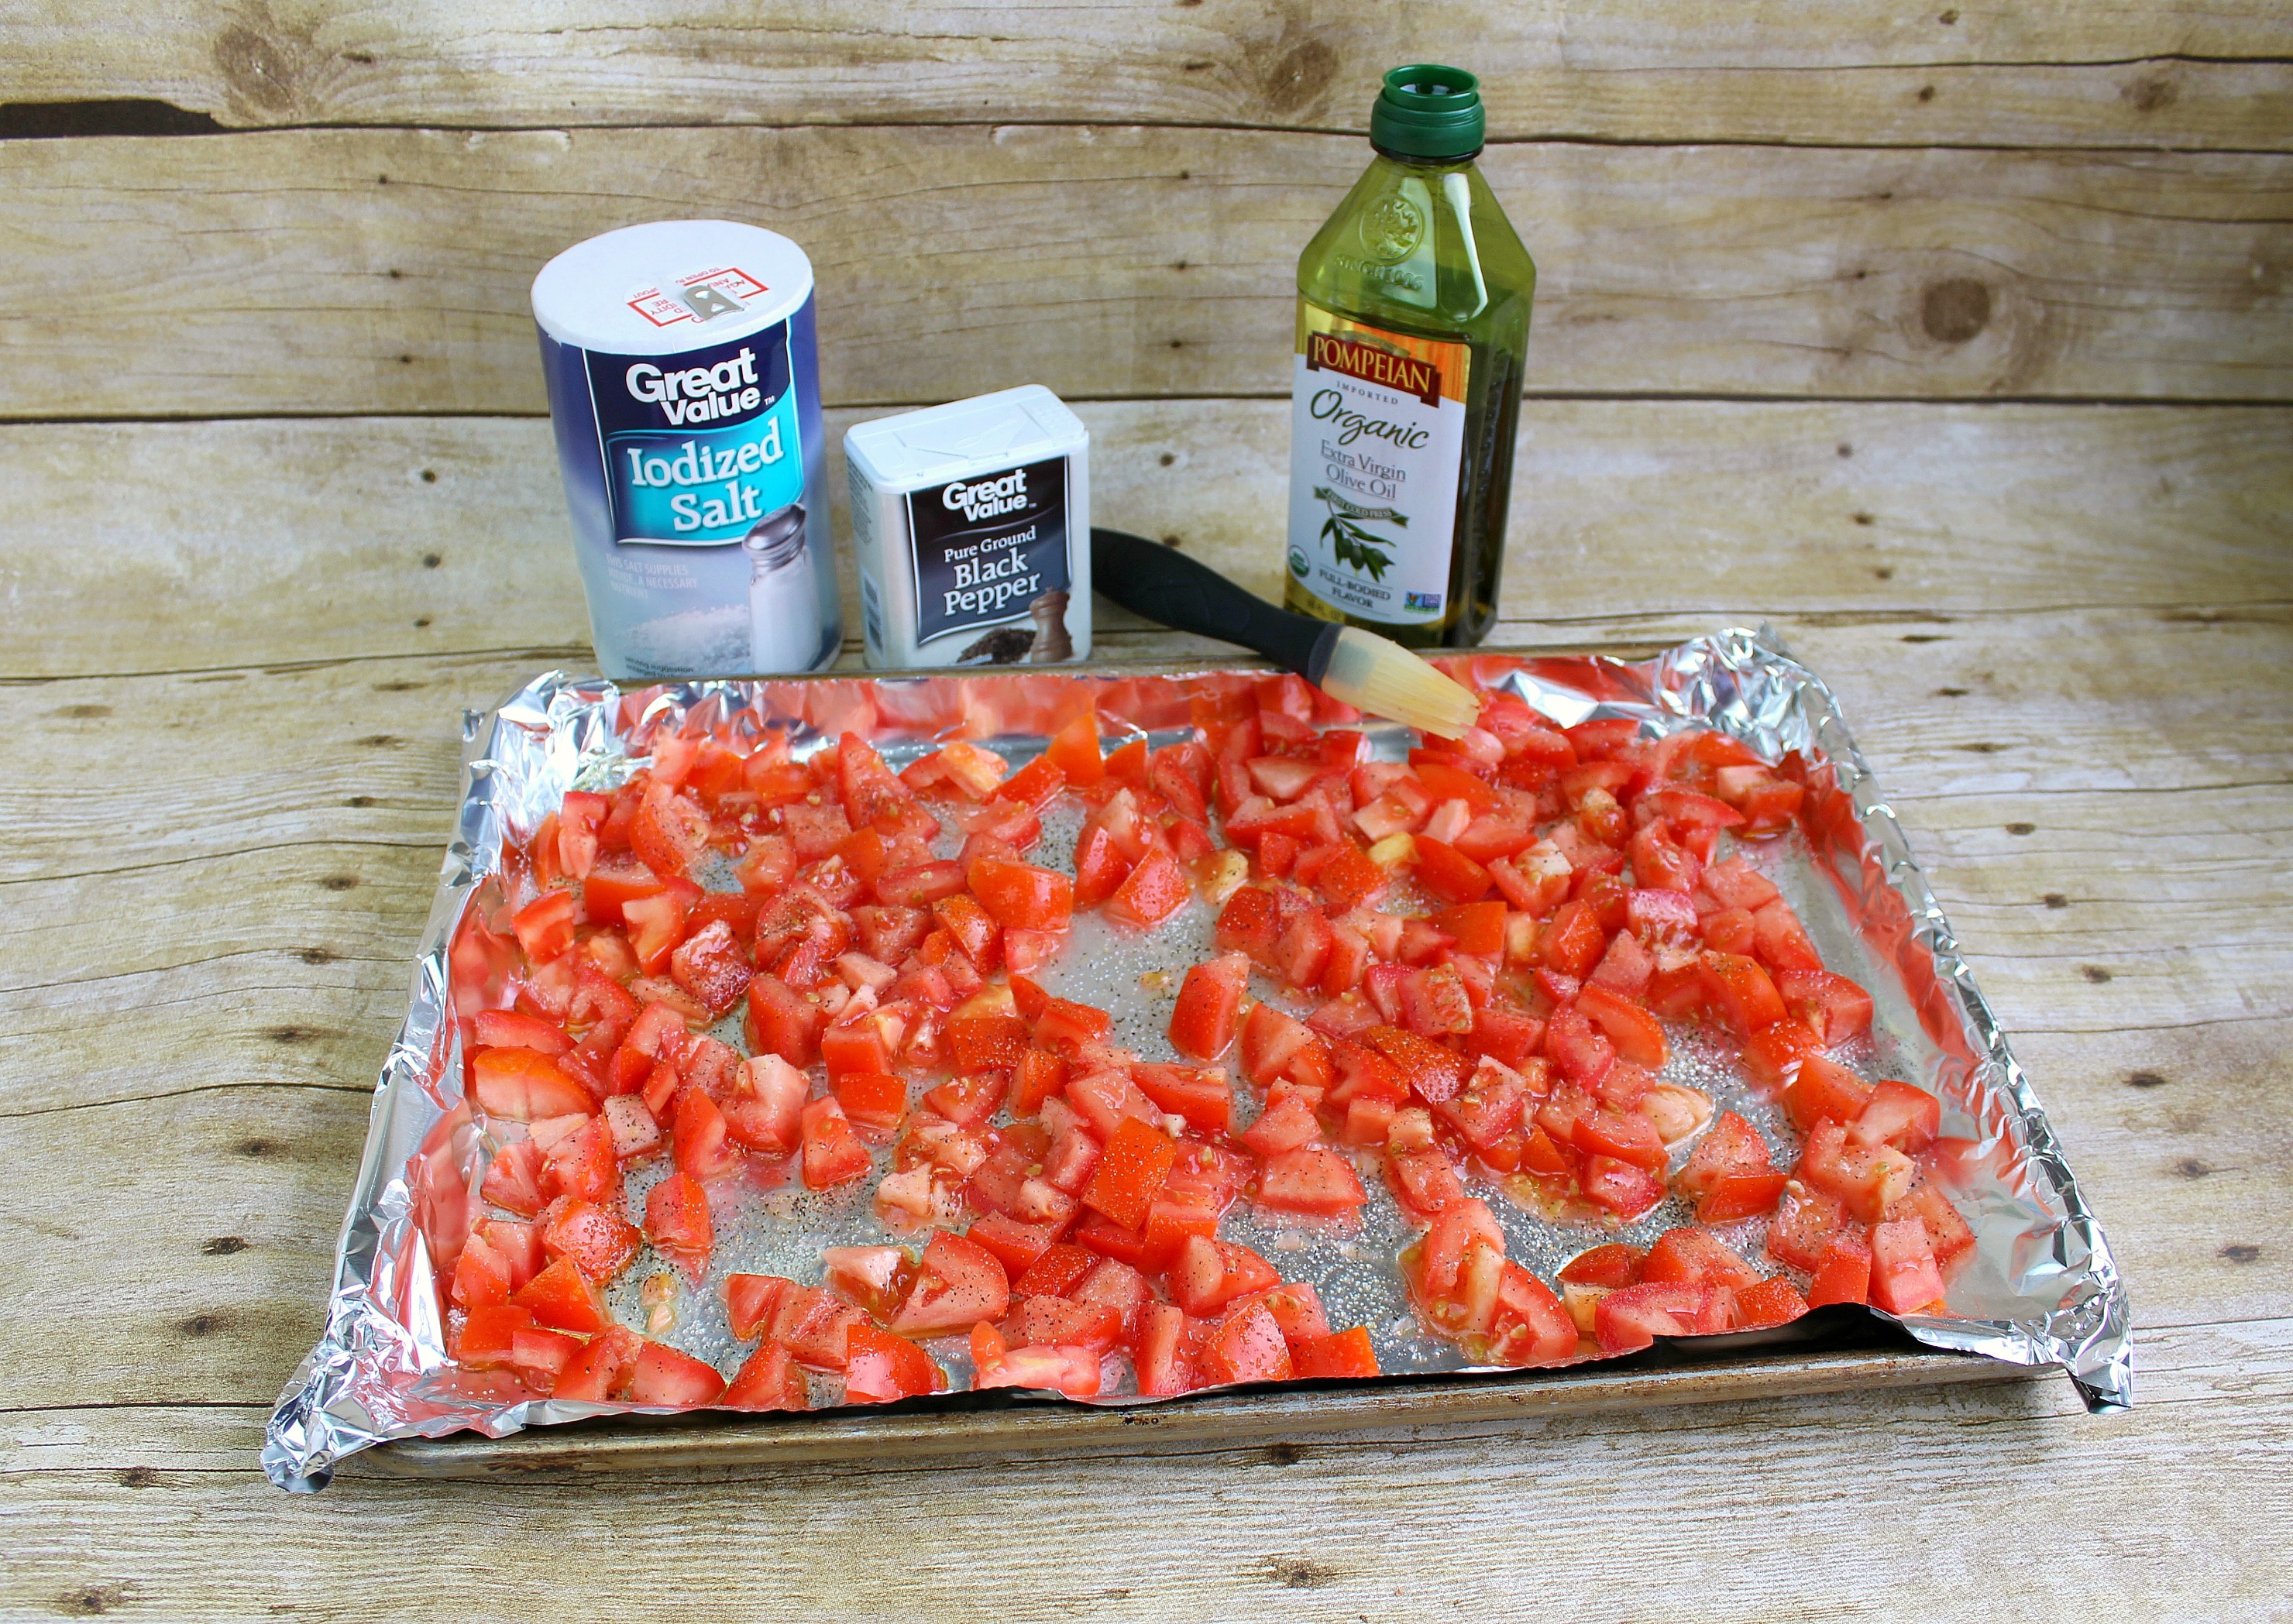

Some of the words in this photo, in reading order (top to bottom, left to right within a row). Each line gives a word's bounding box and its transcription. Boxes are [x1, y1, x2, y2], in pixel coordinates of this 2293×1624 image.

[625, 347, 759, 403] Great
[1312, 335, 1432, 393] POMPEIAN
[1336, 380, 1399, 405] IMPORTED
[1310, 388, 1430, 450] Organic
[626, 416, 785, 488] Iodized
[1321, 438, 1356, 467] Extra
[1358, 452, 1407, 480] Virgin
[942, 468, 1027, 511] Great
[1325, 463, 1366, 491] Olive
[1370, 478, 1397, 500] Oil
[670, 479, 763, 532] Salt
[606, 552, 623, 568] THIS
[624, 558, 642, 573] SALT
[644, 563, 689, 575] SUPPLIES
[944, 544, 978, 563] Pure
[980, 524, 1037, 554] Ground
[645, 575, 697, 589] NECESSARY
[953, 547, 1030, 590] Black
[1318, 568, 1391, 601] FULL-BODIED
[943, 572, 1041, 616] Pepper
[1332, 586, 1373, 608] FLAVOR
